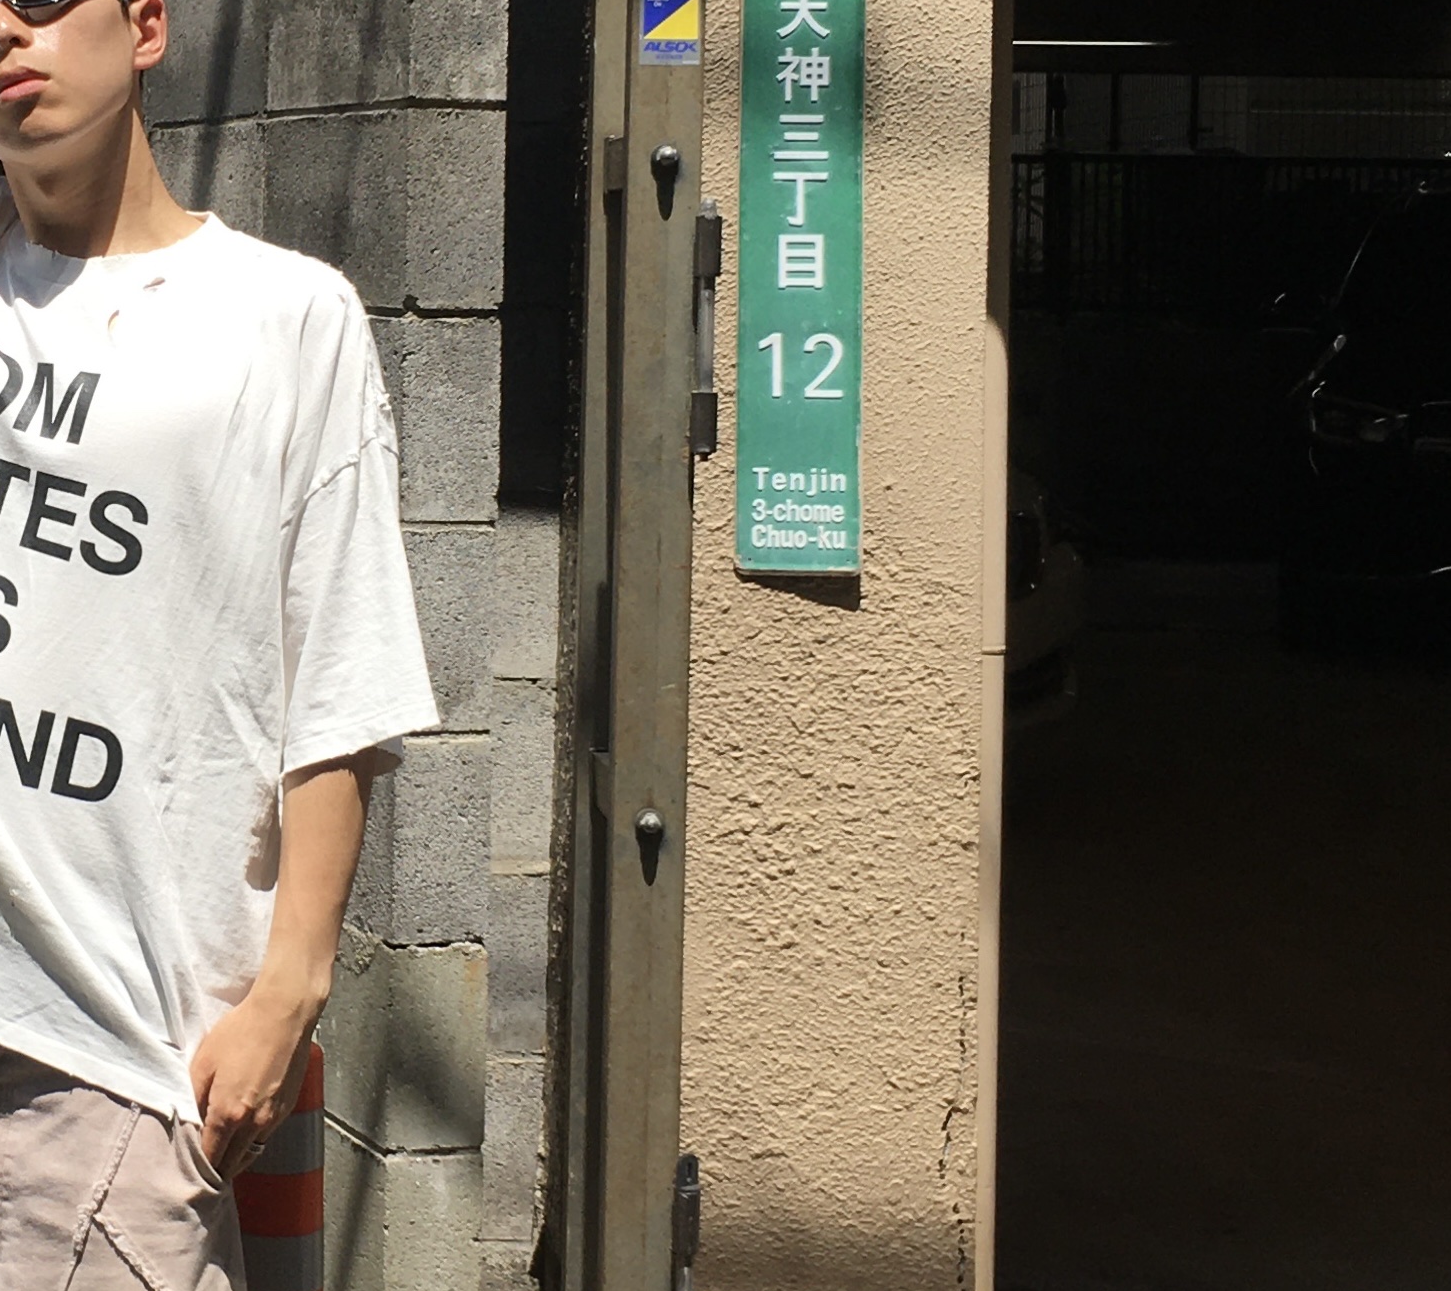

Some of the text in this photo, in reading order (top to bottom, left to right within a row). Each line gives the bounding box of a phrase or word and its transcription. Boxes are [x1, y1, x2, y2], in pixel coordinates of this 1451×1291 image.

[643, 41, 697, 52] ALSOK
[758, 332, 844, 399] 12
[752, 467, 846, 497] Tenjin
[751, 498, 845, 523] 3-chome
[751, 524, 846, 550] Chuo-ku
